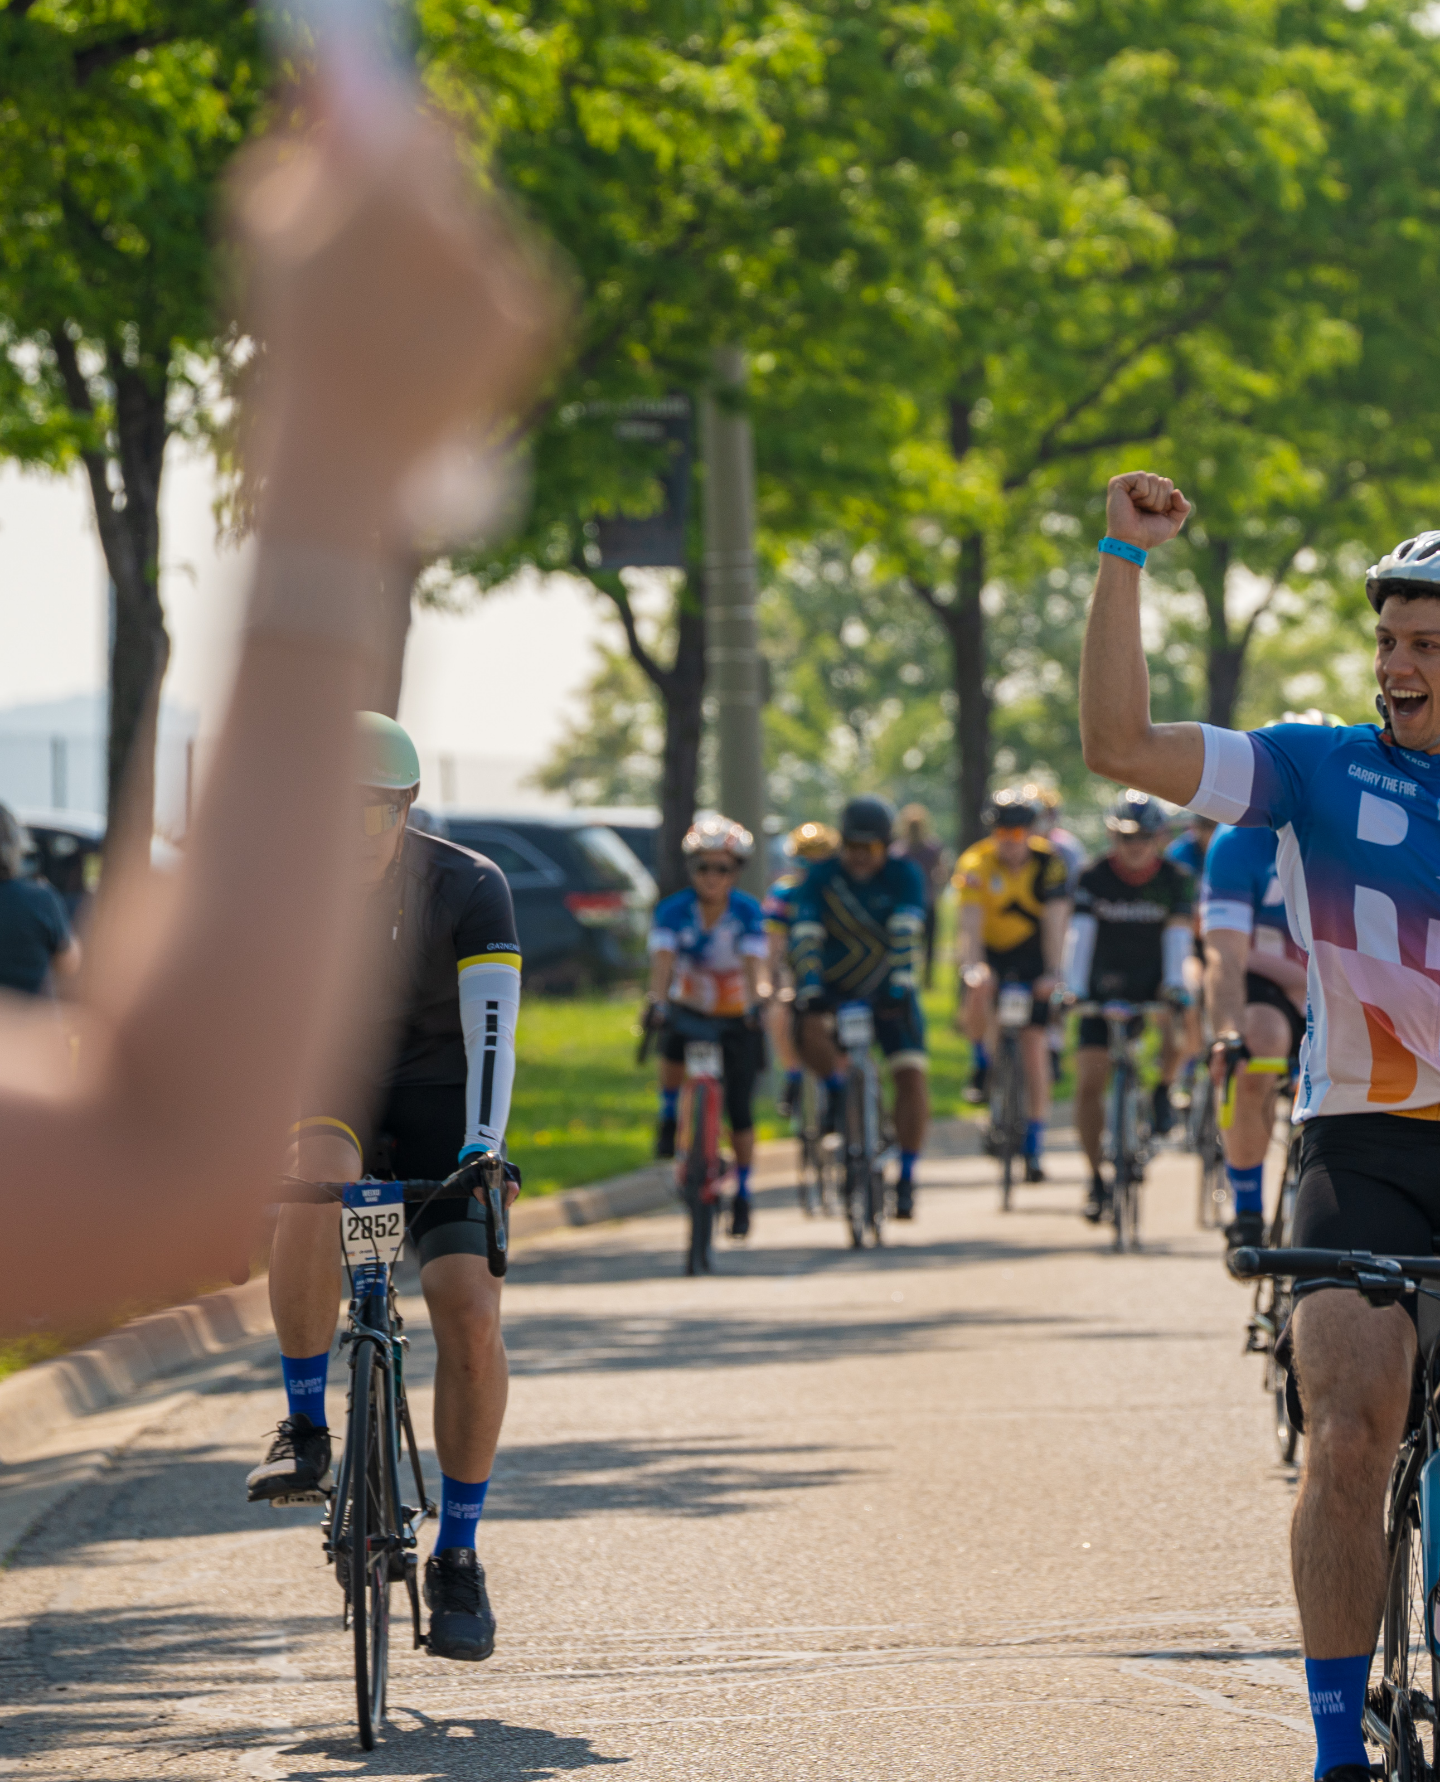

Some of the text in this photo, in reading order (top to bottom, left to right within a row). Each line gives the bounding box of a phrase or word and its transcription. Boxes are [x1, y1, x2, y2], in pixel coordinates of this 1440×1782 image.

[1348, 763, 1418, 797] CARRY THE FIRE
[347, 1212, 400, 1241] 2852
[290, 1376, 323, 1388] CARRY
[447, 1500, 483, 1512] CARRY
[1322, 1701, 1346, 1715] FIRE
